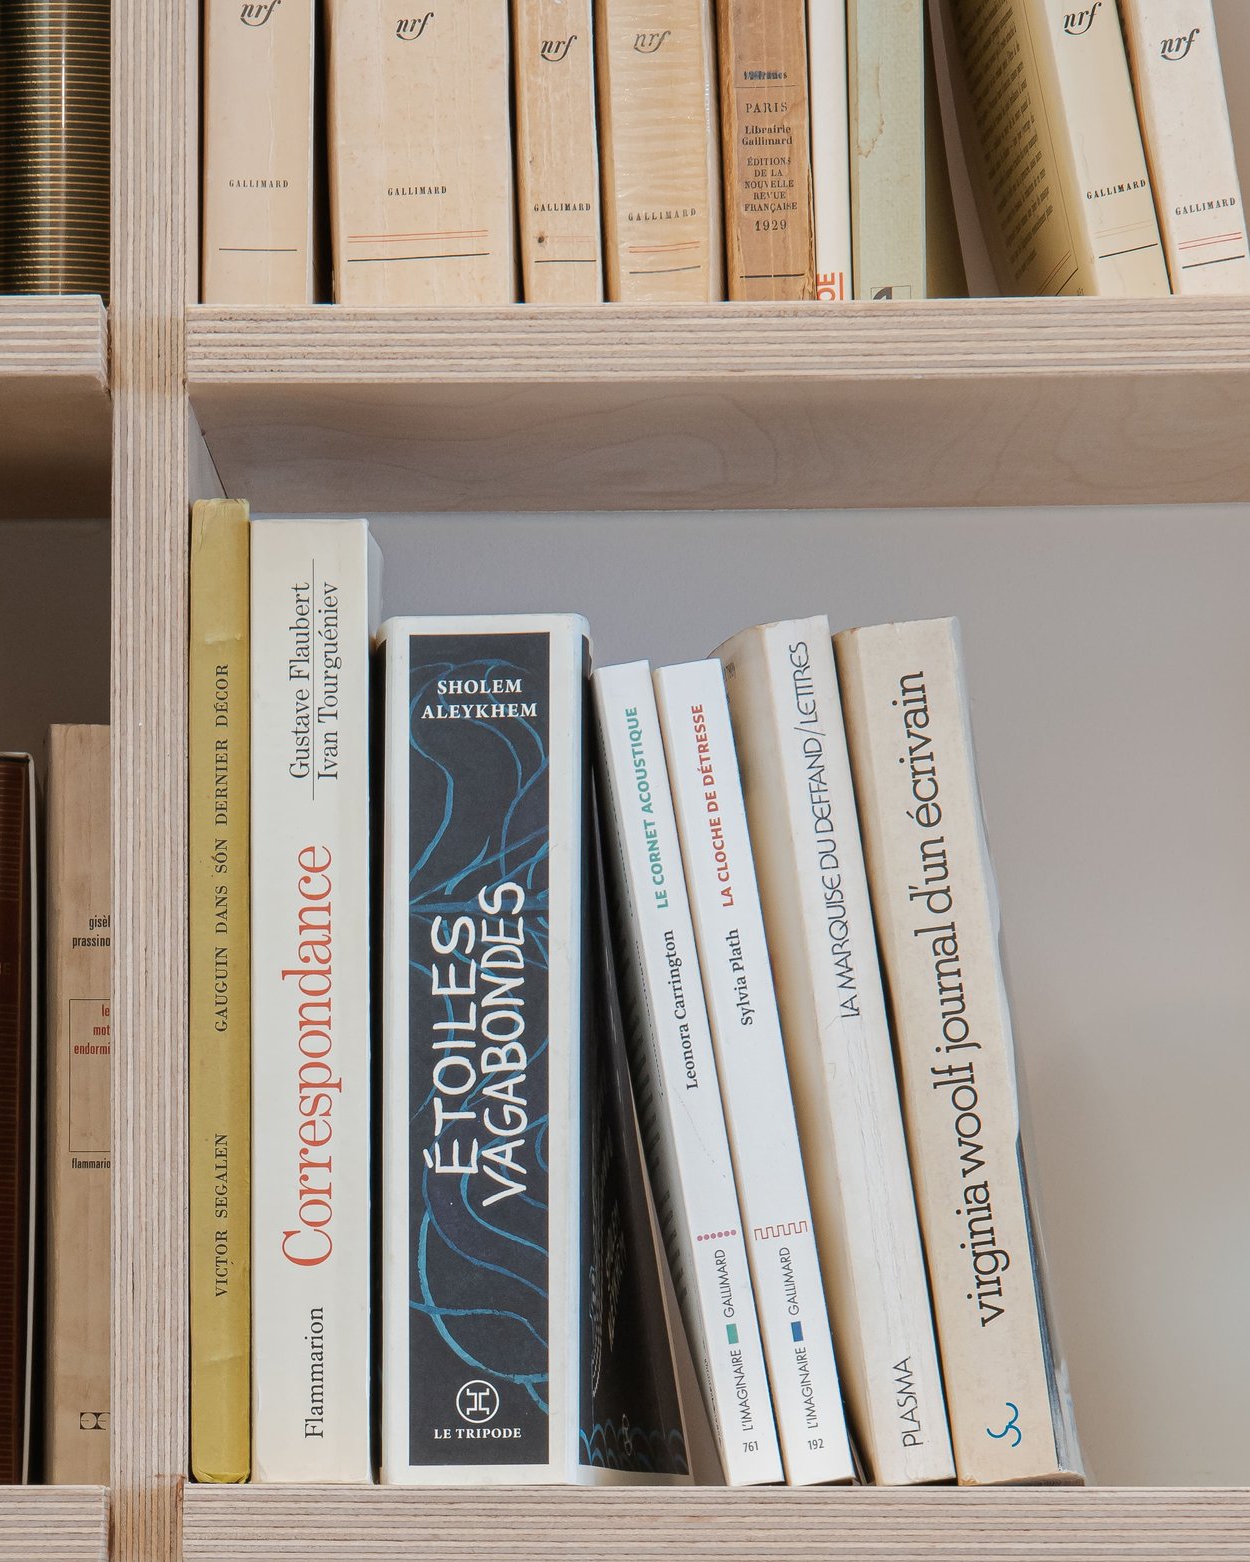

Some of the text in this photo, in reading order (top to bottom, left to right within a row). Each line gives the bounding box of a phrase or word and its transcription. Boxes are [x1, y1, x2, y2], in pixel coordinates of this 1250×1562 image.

[240, 0, 281, 26] nrf
[396, 12, 434, 40] nrf
[1064, 2, 1101, 35] nrf
[541, 35, 577, 61] nrf
[634, 30, 670, 53] nrf
[1160, 28, 1200, 60] nrf
[746, 102, 788, 113] PARIS
[742, 136, 793, 146] Gallimard
[745, 125, 791, 135] Librairie
[747, 157, 791, 168] ÉDITIONS
[754, 169, 783, 178] DE LA
[229, 179, 289, 188] GALLIMARD
[387, 185, 447, 196] GALLIMARD
[744, 180, 794, 190] NOUVELLE
[753, 191, 786, 200] REVUE
[1087, 179, 1146, 200] GALLIMARD
[533, 202, 591, 212] GALLIMARD
[628, 208, 696, 221] GALLIMARD
[744, 202, 797, 213] FRANÇAISE
[1175, 197, 1236, 216] GALLIMARD
[755, 220, 787, 231] 1929
[289, 582, 310, 779] Gustave Flaubert
[317, 582, 342, 781] Ivan Tourguéniev
[436, 678, 523, 695] SHOLEM
[421, 702, 538, 719] ALEYKHEM
[625, 706, 670, 910] LE CORNET ACOUSTIQUE
[690, 703, 735, 908] LA CLOCHE DE DÉTRESSE
[213, 663, 229, 1033] GAUGUIN DANS DERNIER DÉCOR
[816, 838, 861, 1019] LA MARQUISE DU
[726, 928, 754, 1026] Sylvia Plath
[663, 929, 699, 1090] Leonora Carrington
[891, 670, 1010, 1328] virginia woolf journal d'un écrivain
[282, 844, 342, 1268] Correspondance
[423, 914, 480, 1177] ÉTOILES
[478, 881, 529, 1208] VAGABONDES
[215, 1133, 229, 1298] VICTOR SEGALEN
[714, 1249, 735, 1319] GALLIMARD
[779, 1246, 800, 1317] GALLIMARD
[304, 1306, 325, 1440] Flammarion
[892, 1357, 922, 1448] PLASMA
[434, 1428, 522, 1440] LE TRIPODE
[742, 1440, 760, 1453] 761
[807, 1438, 825, 1451] 192
